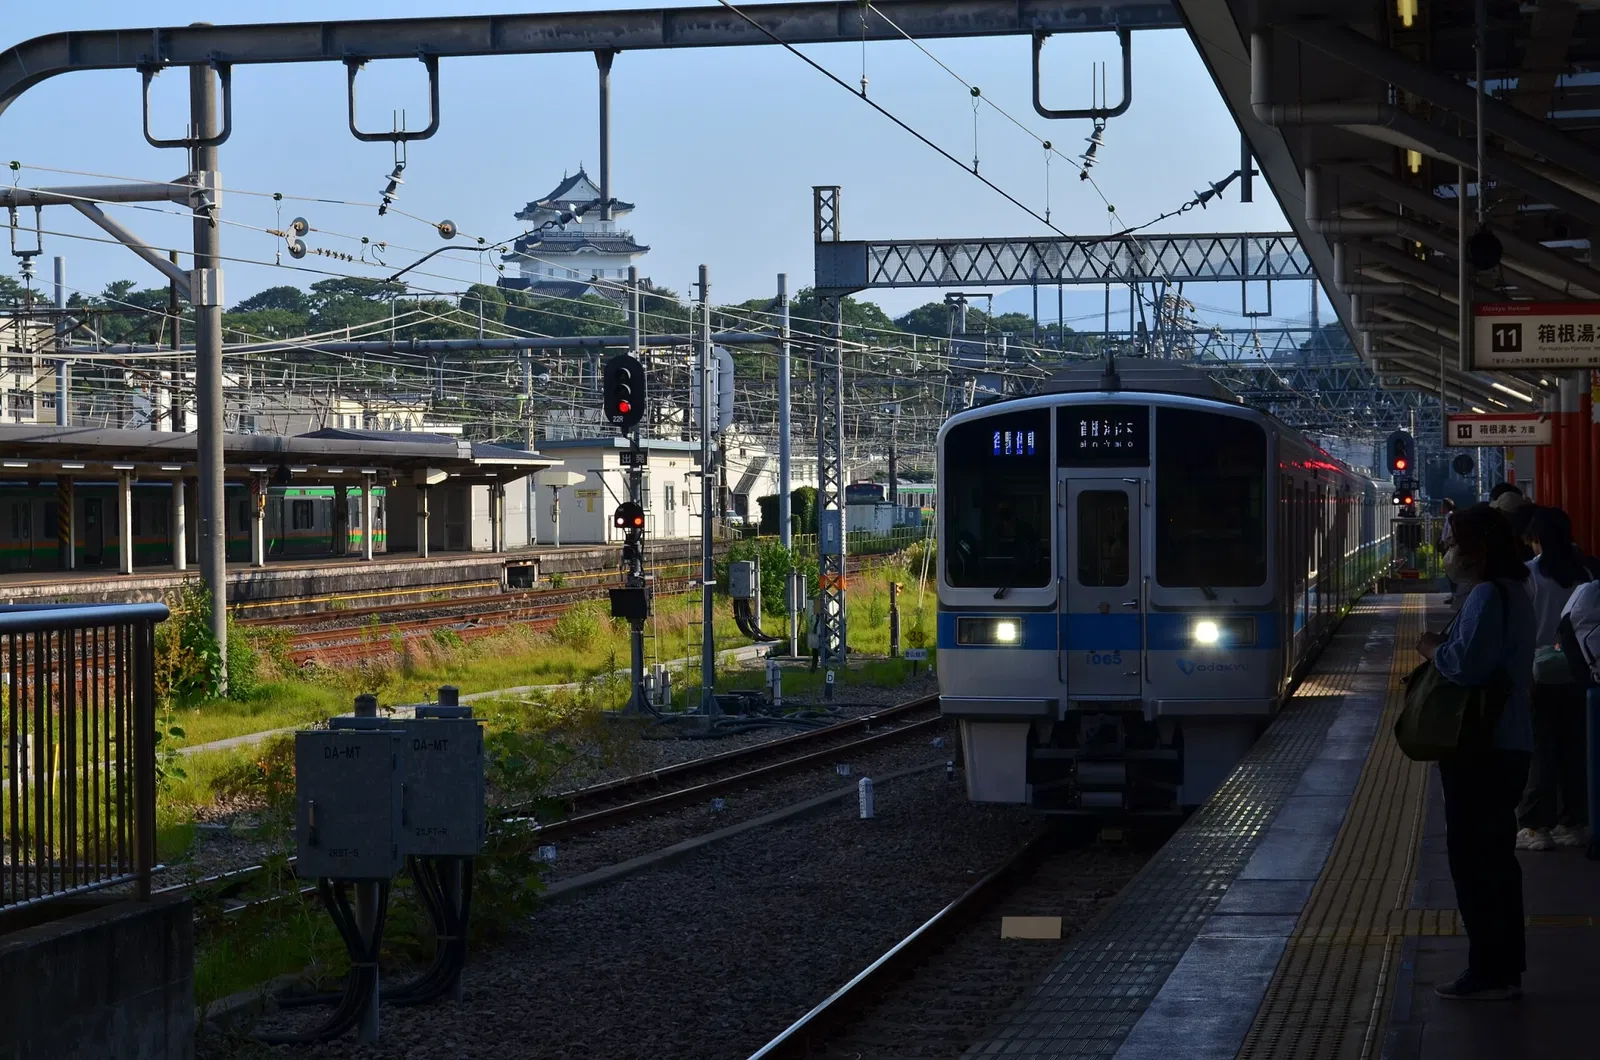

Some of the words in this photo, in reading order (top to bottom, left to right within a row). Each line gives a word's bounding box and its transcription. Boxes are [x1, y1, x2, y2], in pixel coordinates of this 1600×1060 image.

[1495, 328, 1517, 347] 11
[1538, 323, 1600, 343] 箱根湯
[612, 415, 624, 423] 22R
[1459, 427, 1470, 436] 11
[1479, 424, 1517, 434] 箱根湯本
[1521, 425, 1536, 434] 方面
[621, 454, 645, 464] 出発
[909, 631, 923, 642] 33
[1086, 654, 1122, 665] 1065
[827, 674, 834, 682] D
[413, 739, 448, 751] DA-MT
[324, 746, 361, 759] DA-MT
